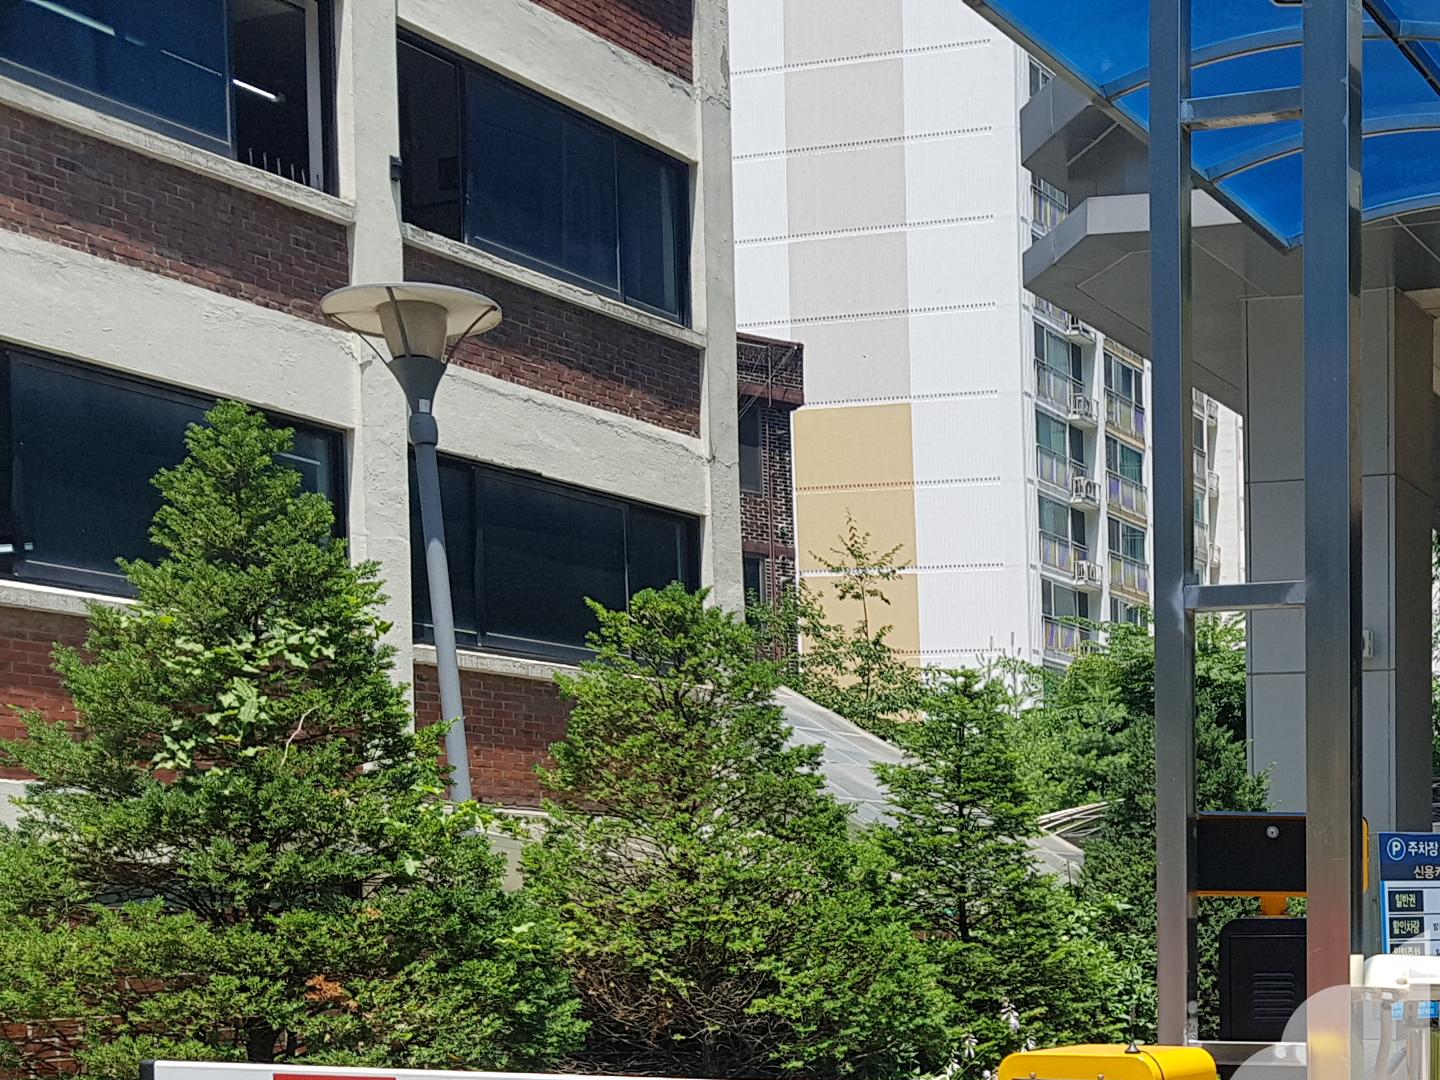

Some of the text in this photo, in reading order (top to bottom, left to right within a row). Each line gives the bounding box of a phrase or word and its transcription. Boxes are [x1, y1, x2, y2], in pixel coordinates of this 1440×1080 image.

[1407, 841, 1439, 857] 주차장
[1394, 893, 1416, 908] 일반권
[1392, 920, 1420, 934] 할인차량
